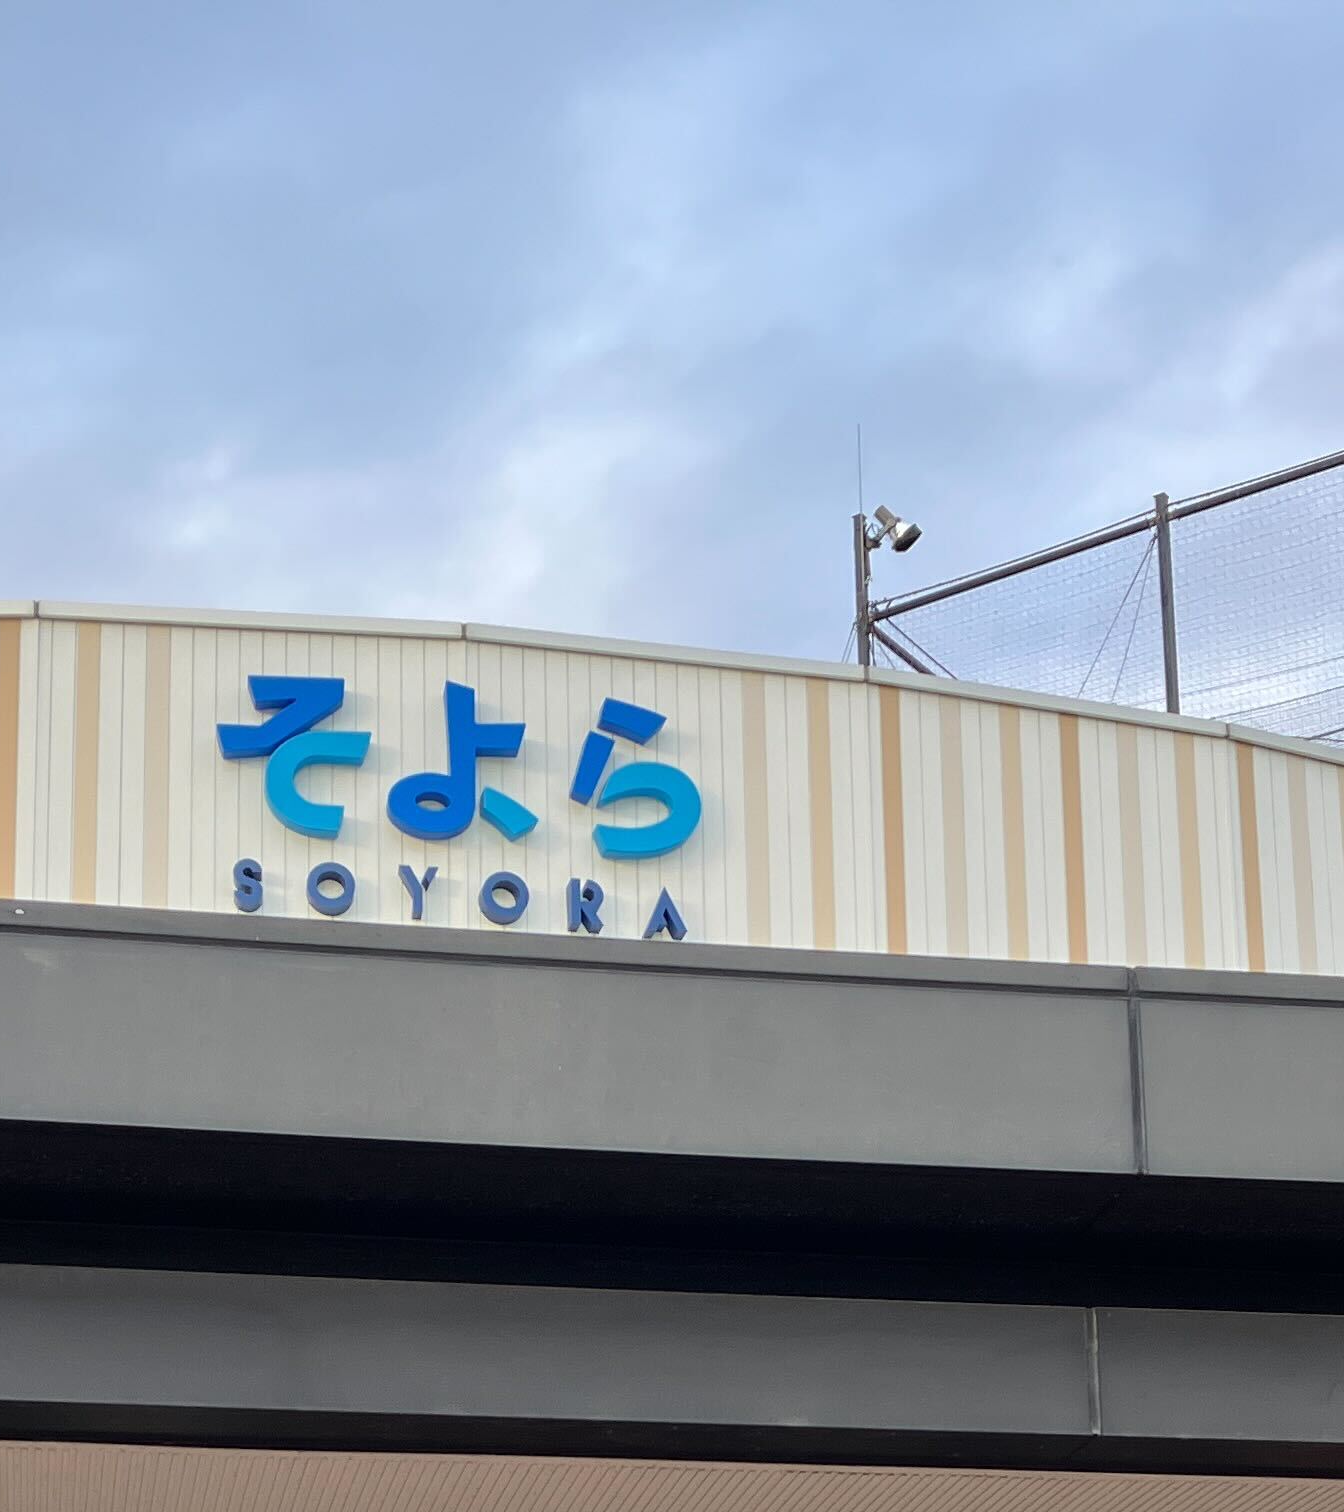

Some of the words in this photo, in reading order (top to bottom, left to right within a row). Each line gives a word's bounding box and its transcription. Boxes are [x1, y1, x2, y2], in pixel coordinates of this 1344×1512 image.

[215, 674, 702, 860] そよら
[232, 857, 688, 941] SOYORA
